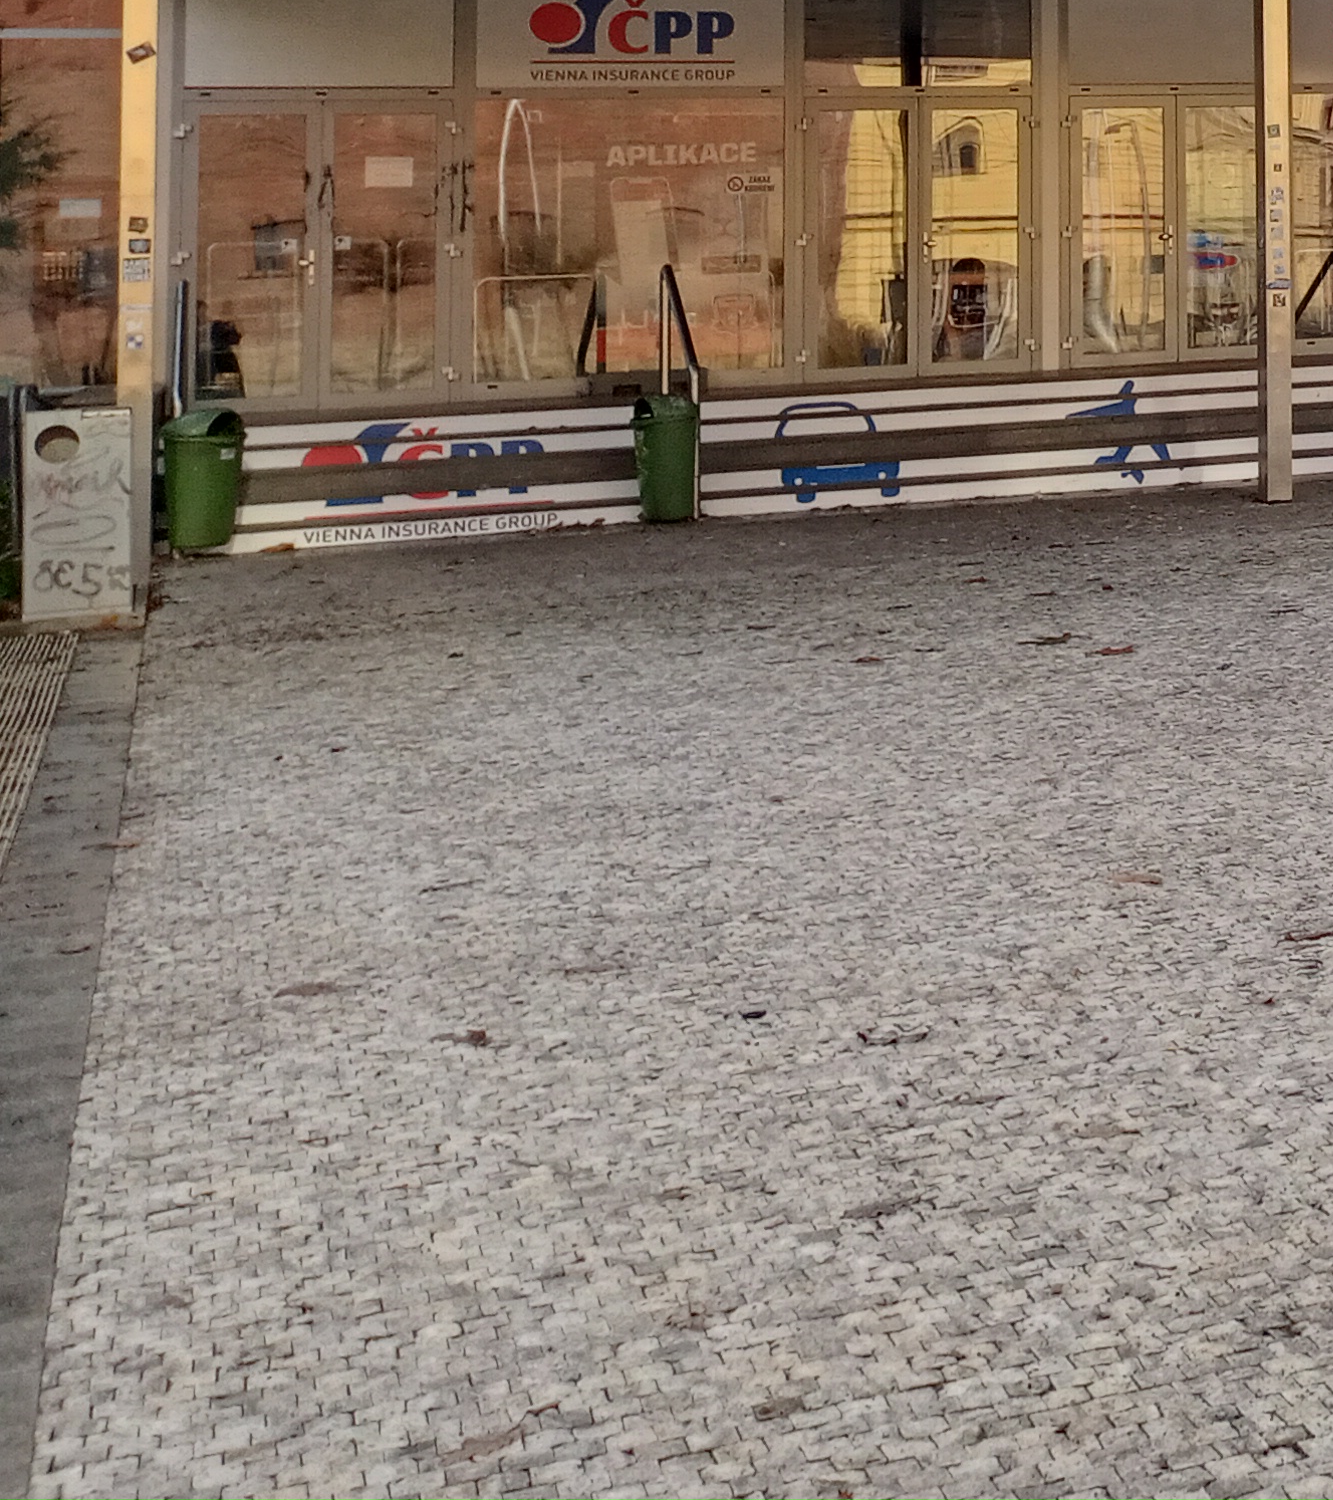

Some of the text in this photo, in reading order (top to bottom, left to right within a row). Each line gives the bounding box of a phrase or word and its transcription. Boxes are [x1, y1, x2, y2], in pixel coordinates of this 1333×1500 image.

[530, 69, 736, 82] VIENNA INSURANCE GROUP
[605, 141, 758, 168] APLIKACE
[303, 512, 559, 545] VIENNA INSURANCE GROUP
